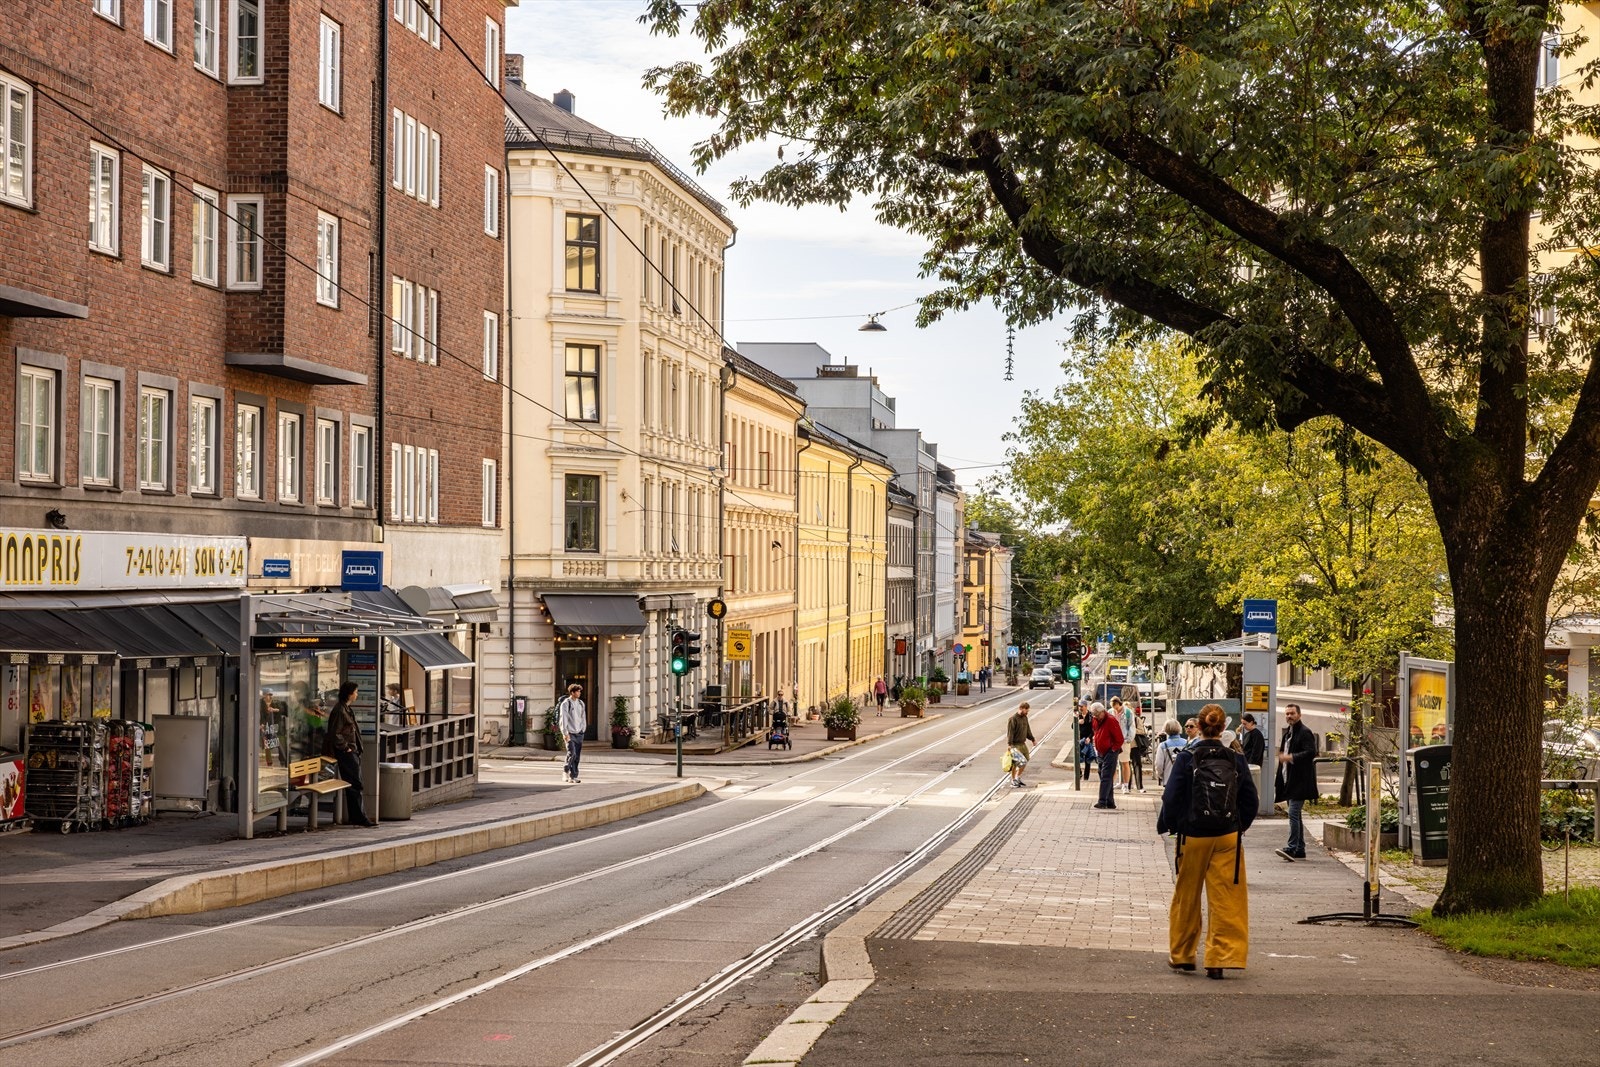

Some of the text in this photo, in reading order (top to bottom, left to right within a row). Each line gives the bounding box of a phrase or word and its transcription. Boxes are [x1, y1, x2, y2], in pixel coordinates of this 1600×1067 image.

[0, 532, 82, 585] NNPRIS
[194, 547, 216, 577] SØN
[218, 547, 244, 577] 8-24
